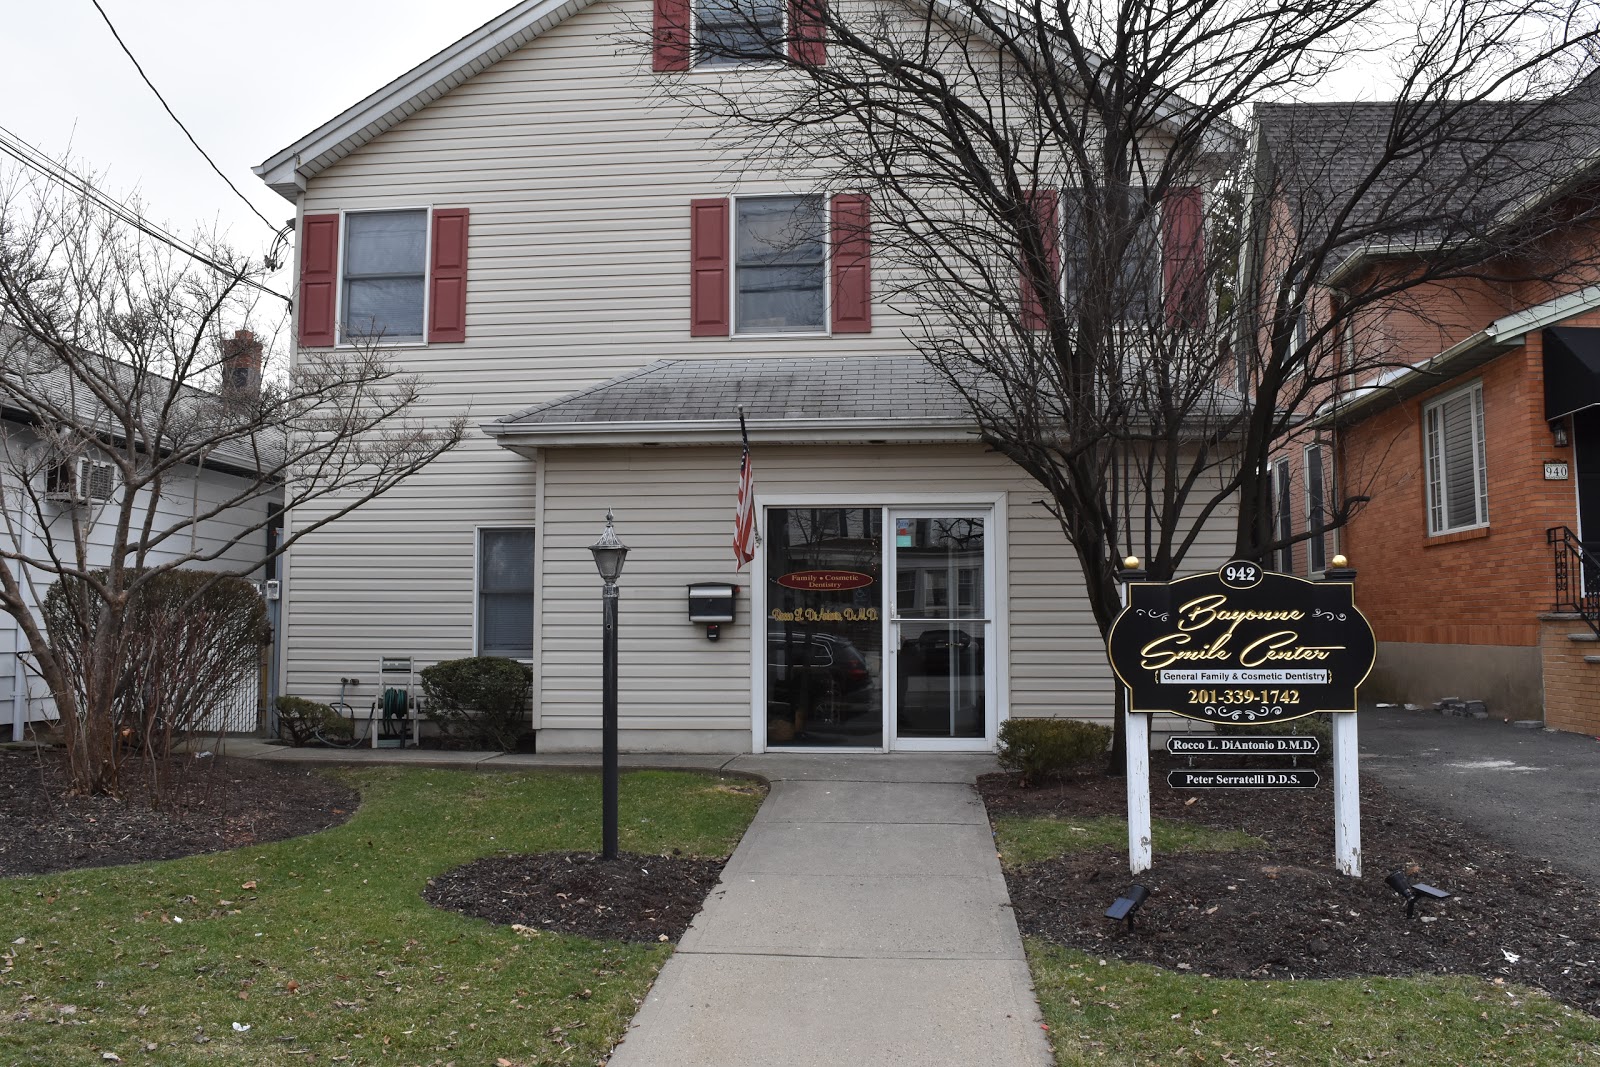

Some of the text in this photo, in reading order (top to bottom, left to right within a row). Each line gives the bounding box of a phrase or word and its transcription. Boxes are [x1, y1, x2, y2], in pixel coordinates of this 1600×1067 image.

[1546, 467, 1567, 476] 940
[1226, 567, 1255, 581] 942
[1178, 594, 1305, 634] Bayonne
[1140, 631, 1346, 669] Smile Center
[1201, 673, 1229, 681] Family
[1285, 673, 1326, 681] Dentistry
[1188, 689, 1300, 704] 201-339-1742
[1173, 740, 1315, 750] Rocco L. DiAntonio D.M.D.
[1186, 774, 1300, 784] Peter Serratelli D.D.S.
